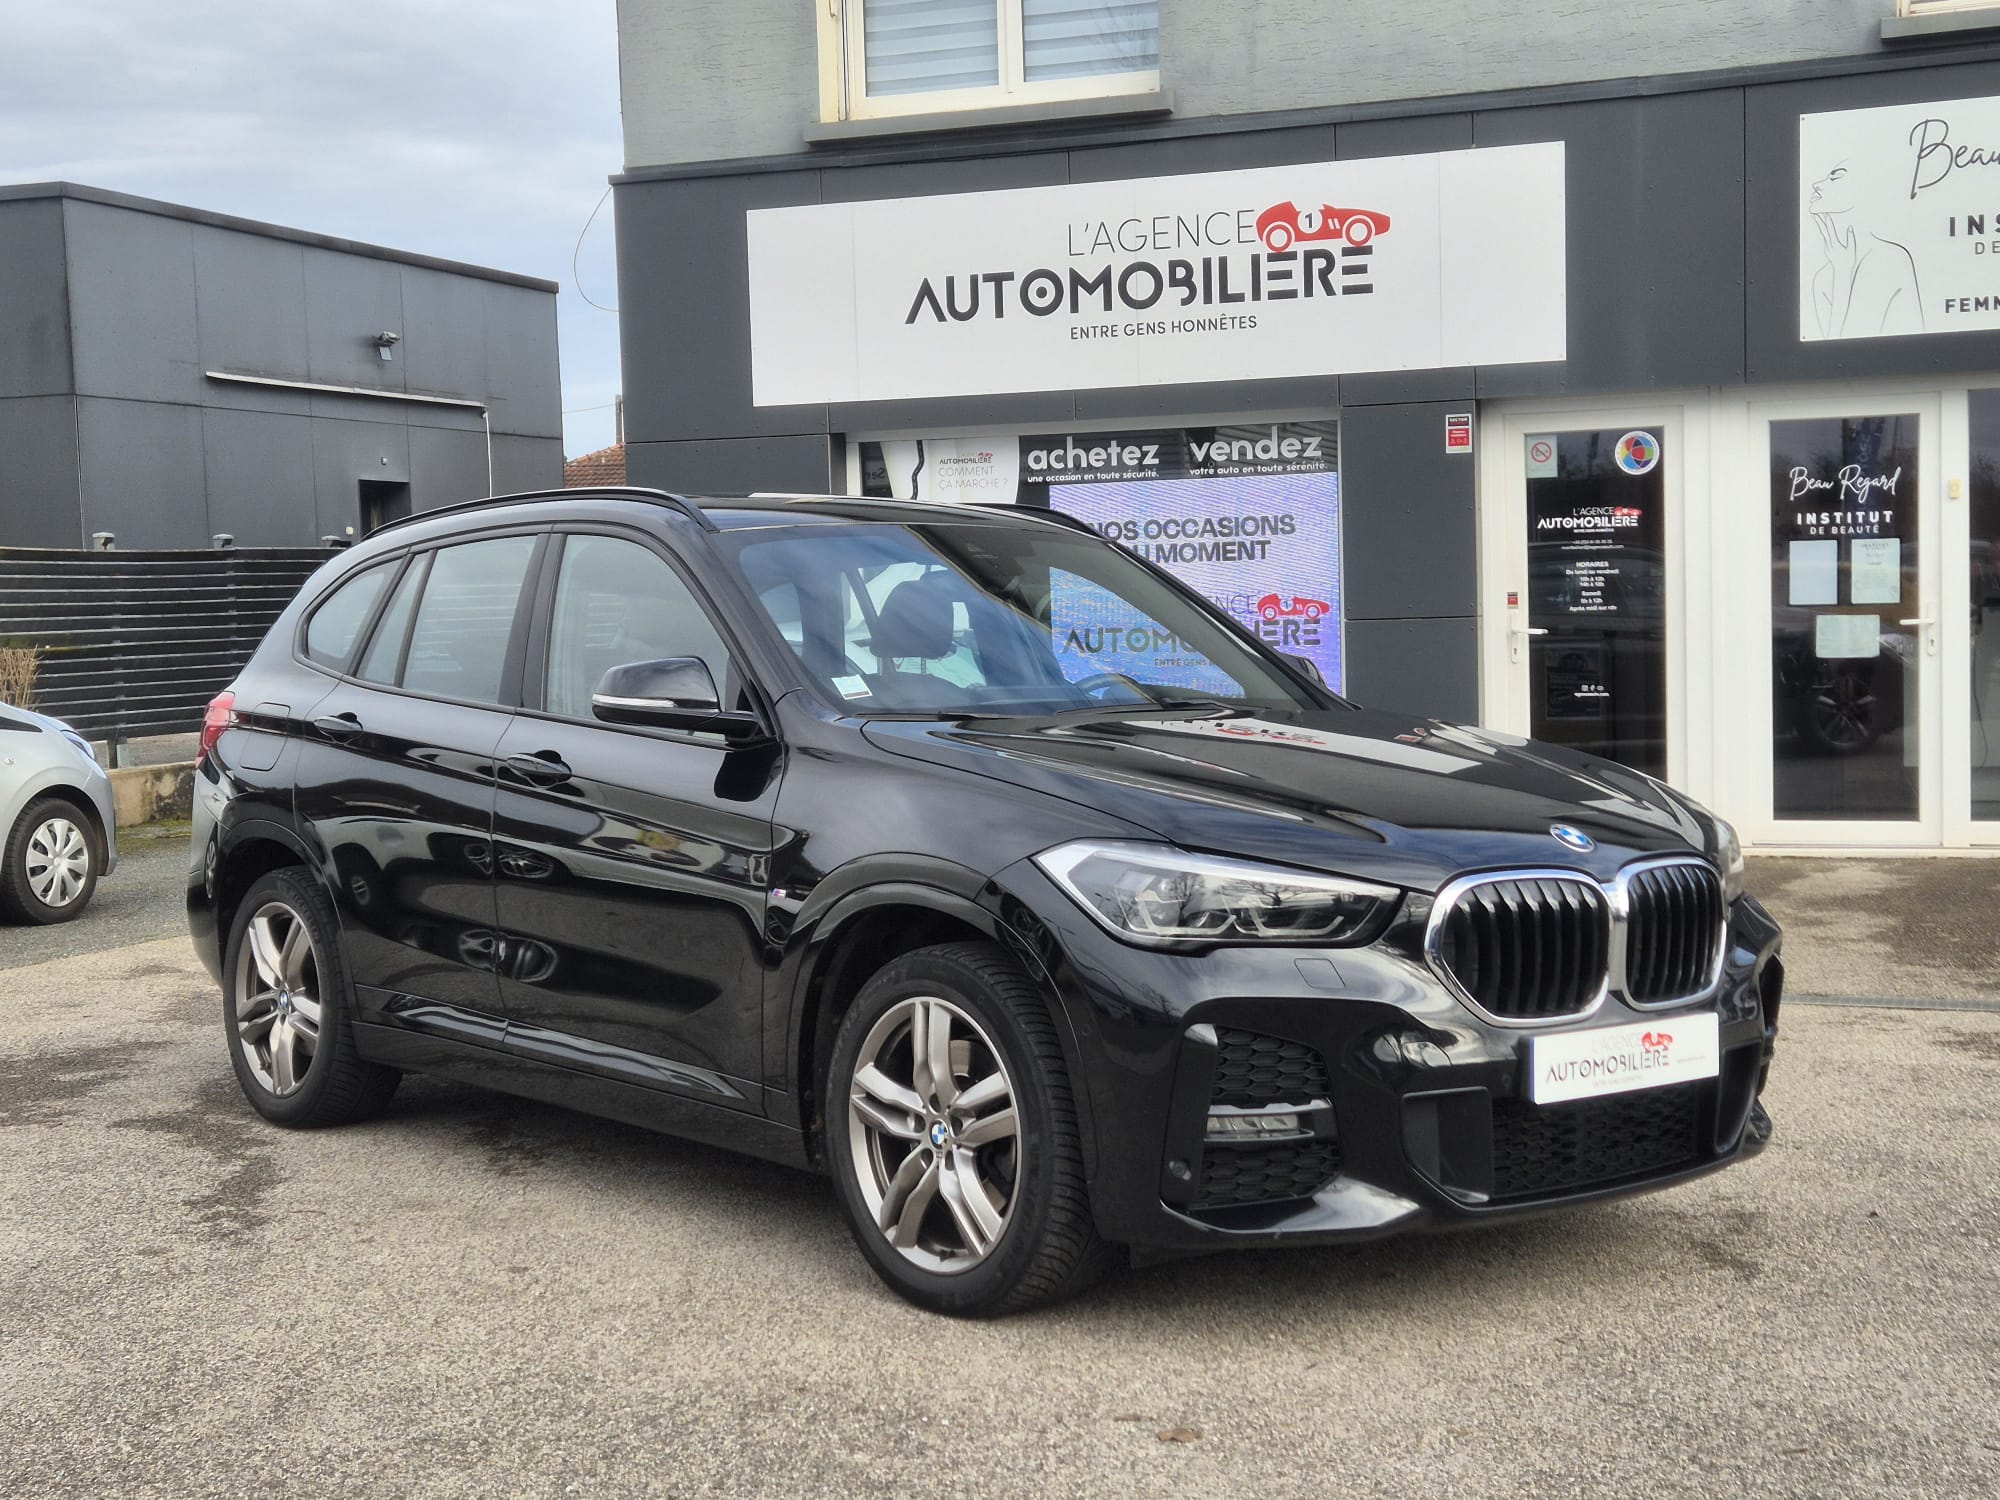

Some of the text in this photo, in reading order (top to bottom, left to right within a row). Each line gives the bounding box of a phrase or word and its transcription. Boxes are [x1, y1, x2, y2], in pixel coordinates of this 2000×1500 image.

[1304, 213, 1313, 229] 1
[1068, 209, 1256, 256] L'AGENCE
[1975, 241, 2000, 255] DE
[1070, 313, 1257, 340] ENTRE GENS HONNÊTES
[1189, 425, 1322, 462] vendez
[1027, 436, 1160, 470] achetez
[938, 465, 994, 477] COMMENT
[1027, 475, 1044, 483] une
[1045, 471, 1081, 482] occasion
[1097, 471, 1121, 480] toute
[1190, 467, 1215, 476] votre
[1217, 465, 1240, 474] auto
[1257, 464, 1283, 473] toute
[938, 480, 953, 491] ÇA
[955, 478, 999, 489] MARCHE
[1789, 464, 1902, 504] Beau Regard
[1573, 506, 1614, 516] L'AGENCE
[1796, 510, 1893, 525] INSTITUT
[1143, 514, 1296, 541] OCCASIONS
[1810, 524, 1880, 535] DE BEAUTÉ
[1155, 540, 1271, 563] MOMENT
